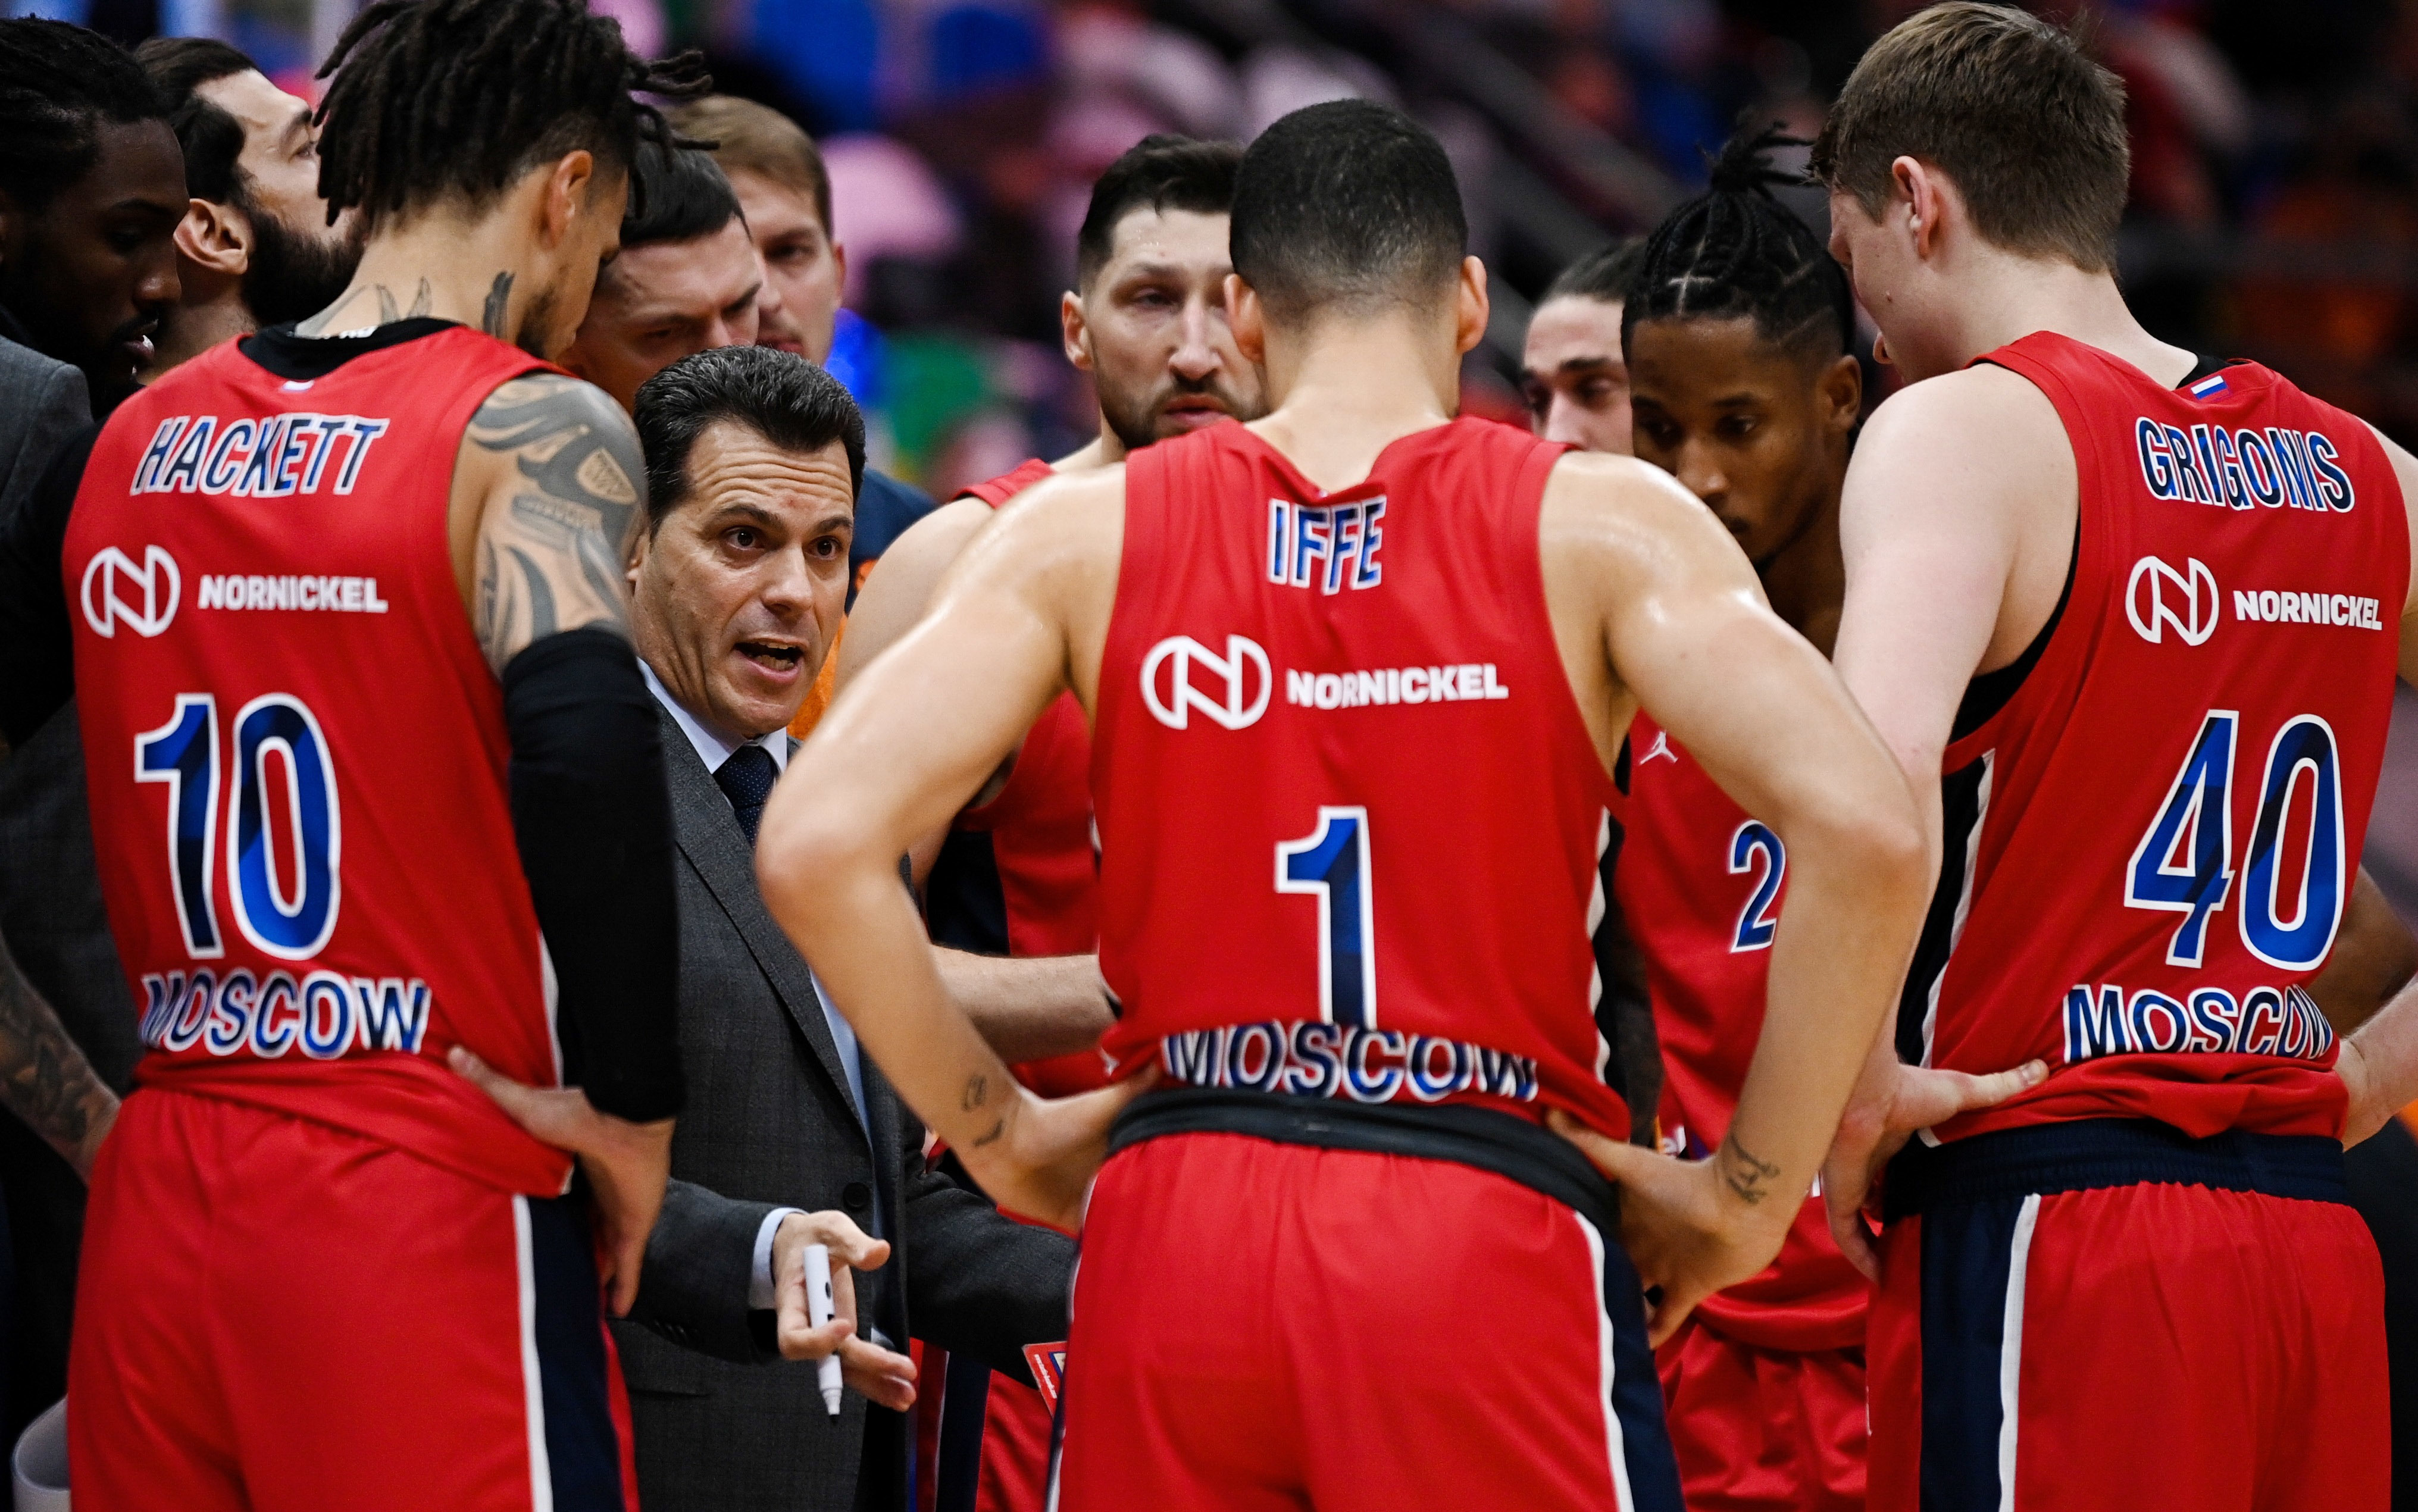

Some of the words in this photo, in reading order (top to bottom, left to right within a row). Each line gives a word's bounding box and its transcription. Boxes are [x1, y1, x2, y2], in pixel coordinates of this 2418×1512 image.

[130, 413, 390, 497] HACKETT
[2135, 417, 2355, 513] GRIGONIS
[1268, 495, 1387, 595] IFFE
[198, 575, 388, 613] NORNICKEL
[2233, 590, 2382, 630] NORNICKEL
[1286, 663, 1509, 709] NORNICKEL
[134, 693, 342, 961] 10
[2124, 709, 2345, 971] 40
[1275, 806, 1377, 1031] 1
[1729, 819, 1785, 953] 2
[1162, 1019, 1539, 1103] MOSCOW
